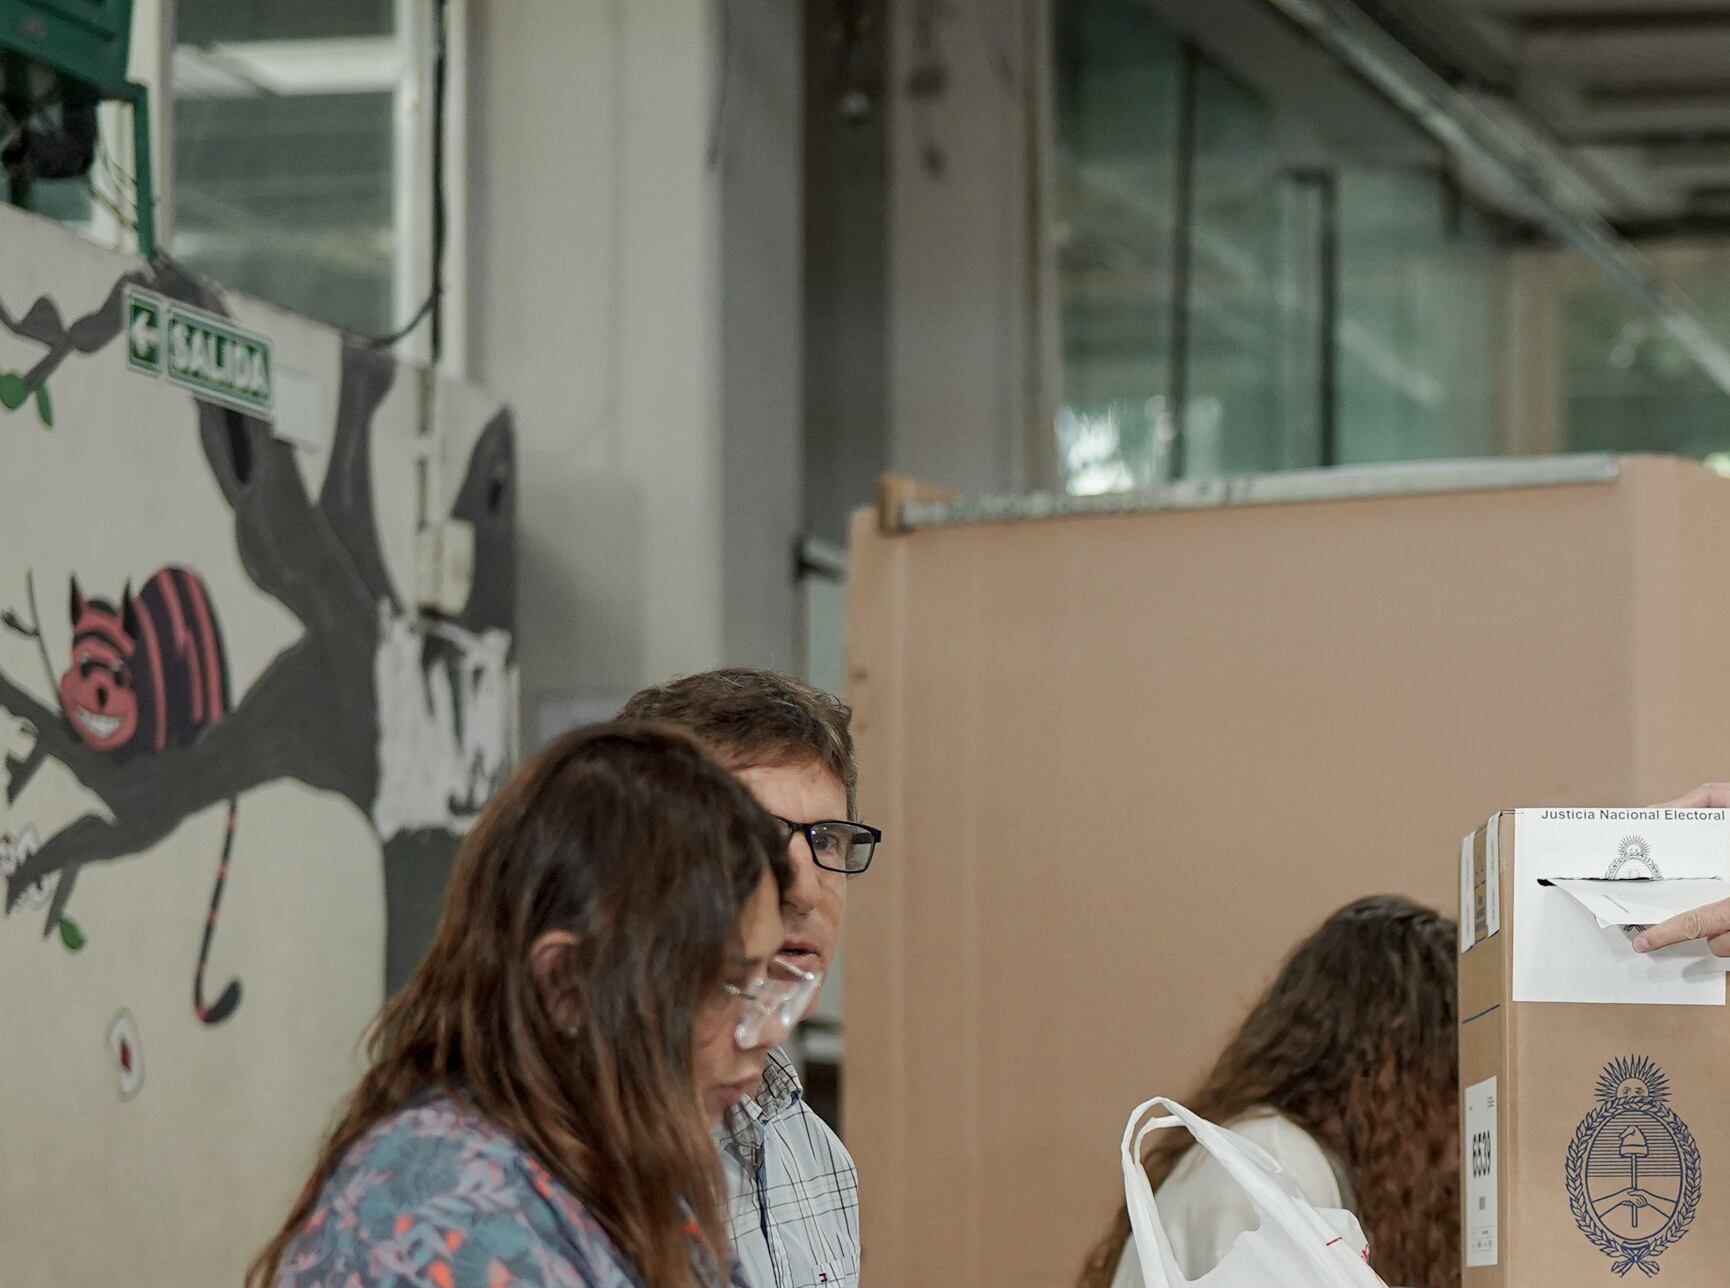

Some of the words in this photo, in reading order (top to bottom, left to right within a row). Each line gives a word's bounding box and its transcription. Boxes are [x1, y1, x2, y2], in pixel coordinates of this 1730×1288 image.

[172, 323, 268, 391] SALIDA
[1541, 809, 1595, 820] Justicia
[1600, 809, 1660, 821] Nacional
[1664, 810, 1726, 821] Electoral
[1472, 1130, 1492, 1178] 6539
